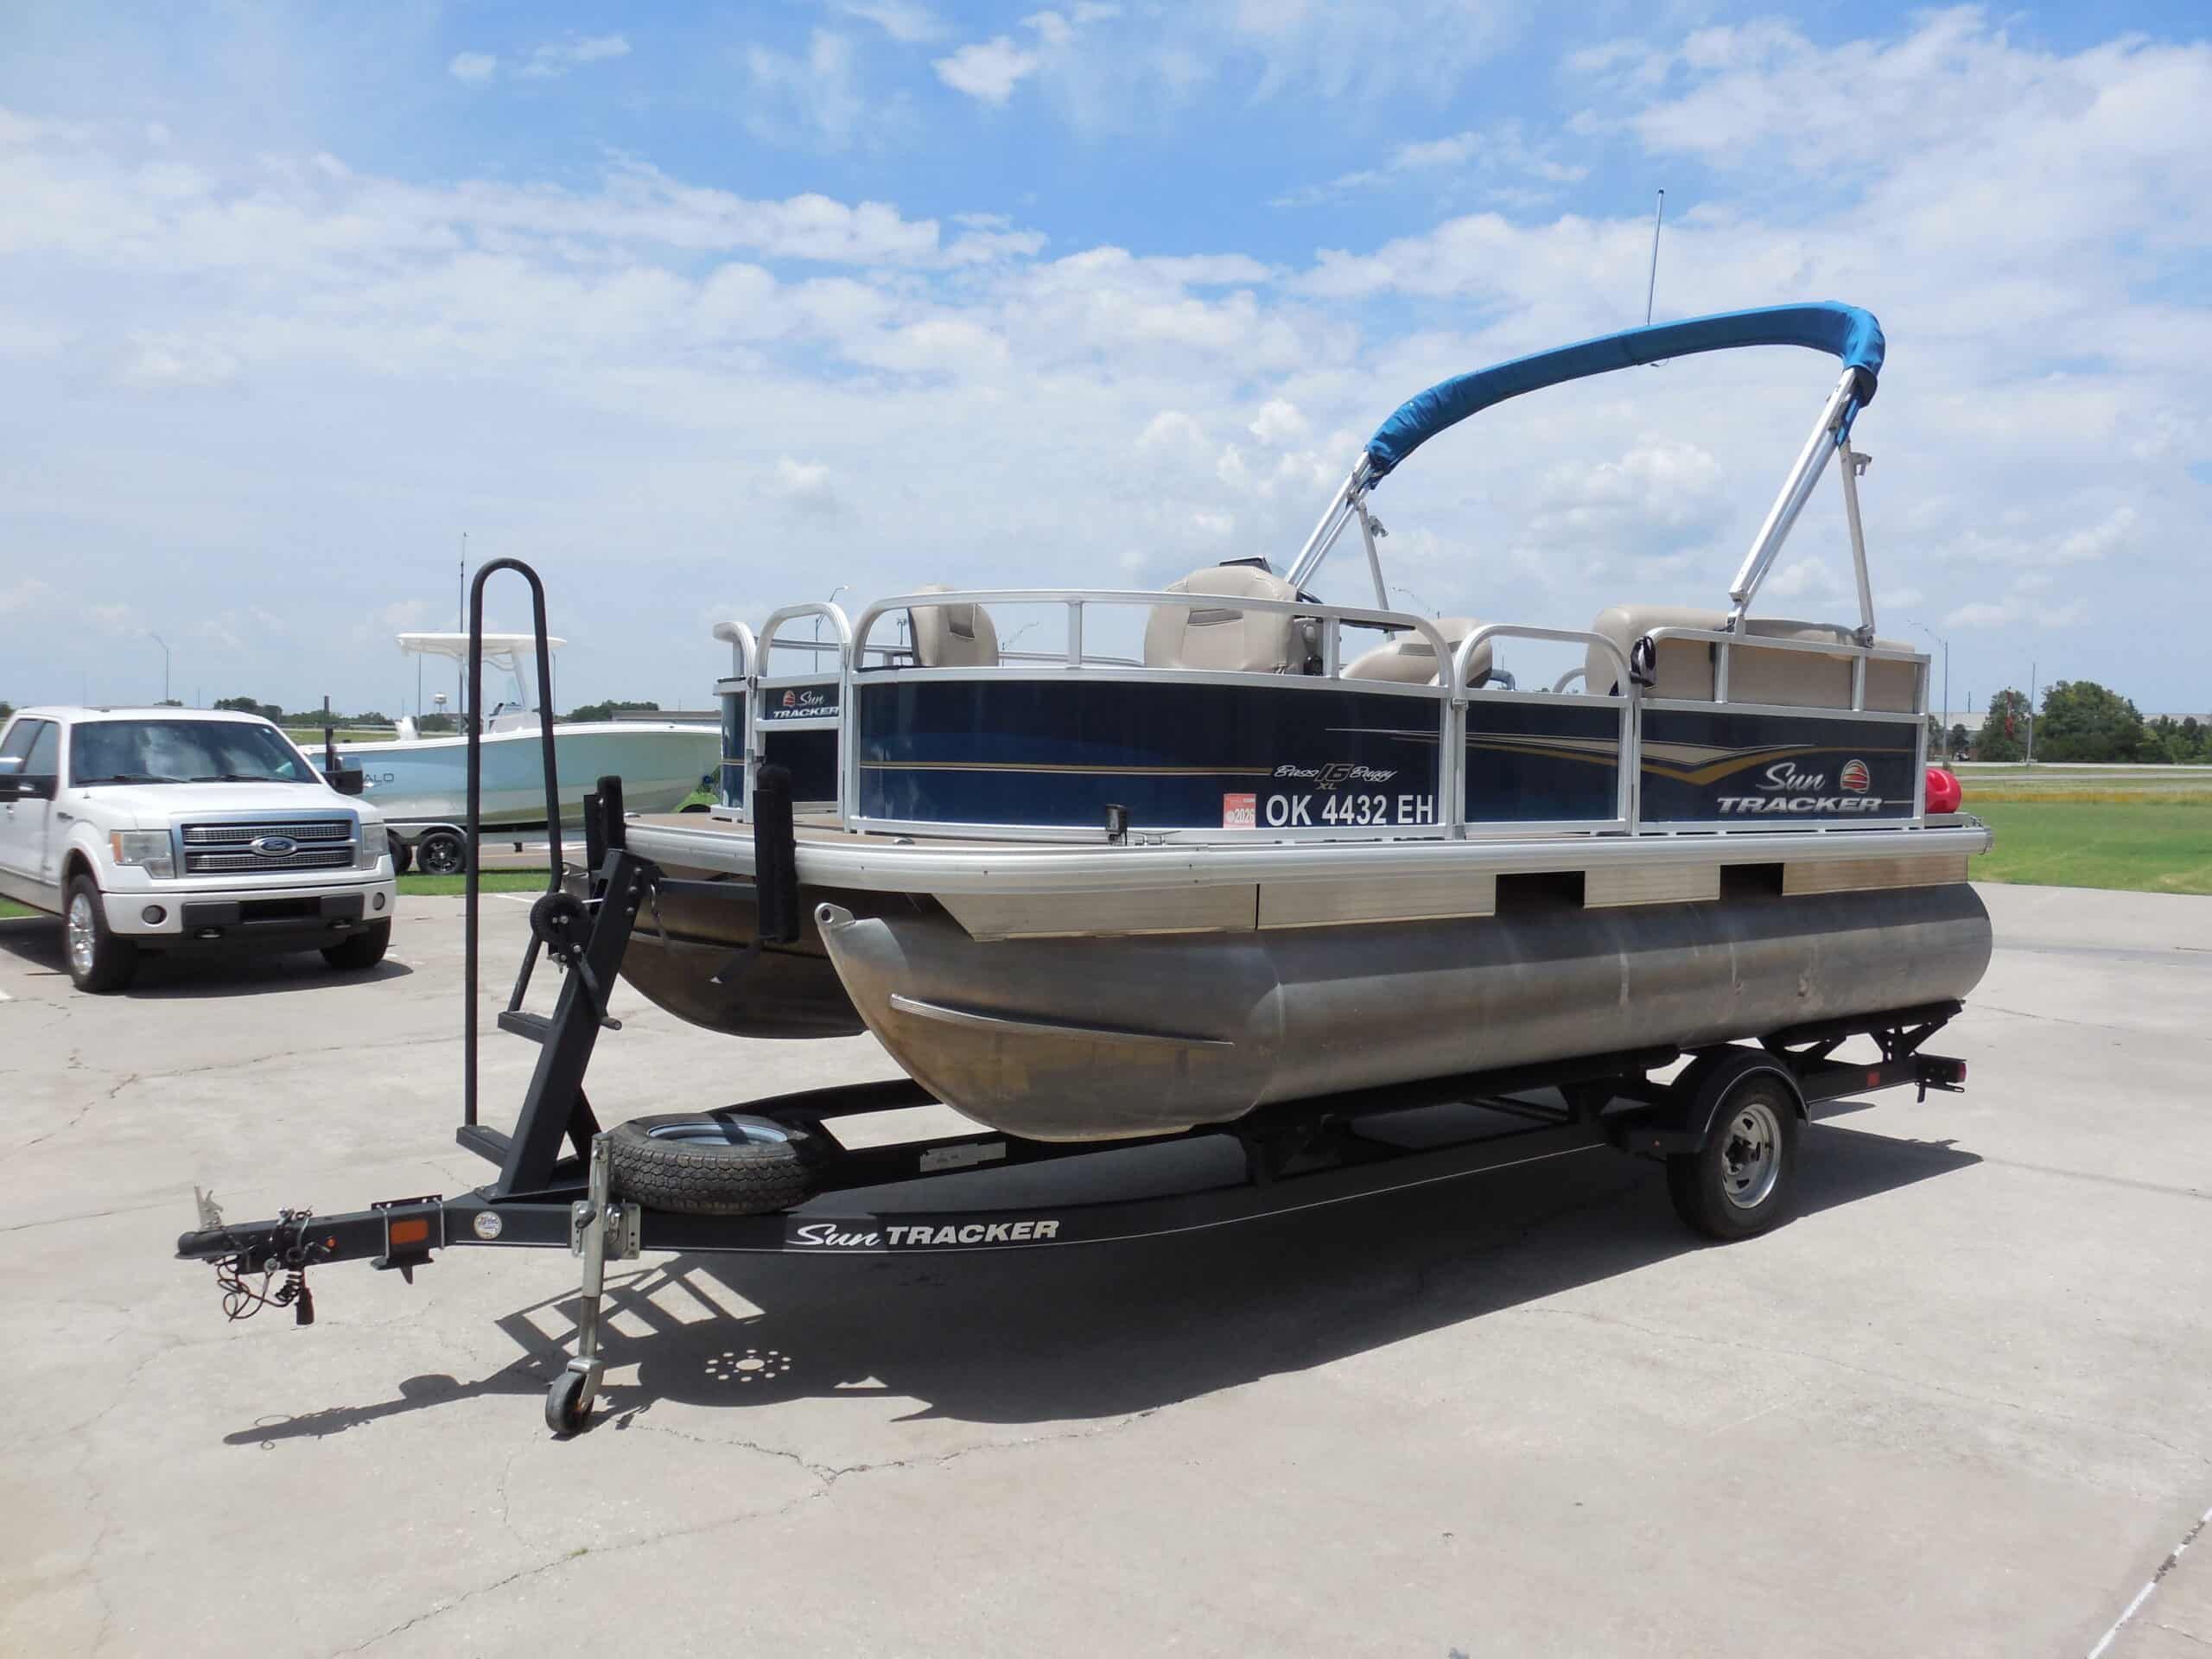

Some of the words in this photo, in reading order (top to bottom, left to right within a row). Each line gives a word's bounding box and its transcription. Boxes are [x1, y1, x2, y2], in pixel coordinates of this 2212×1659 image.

[797, 691, 824, 707] Sun
[773, 706, 839, 719] TRACKER
[1274, 765, 1320, 778] Bass
[1349, 766, 1397, 783] Buggy
[1755, 761, 1826, 791] Sun
[1315, 782, 1338, 791] XL
[1266, 794, 1313, 827] OK
[1322, 794, 1387, 826] 4432
[1397, 794, 1433, 824] EH
[1717, 796, 1883, 814] TRACKER
[785, 1223, 881, 1246] Sun
[886, 1220, 1060, 1246] TRACKER
